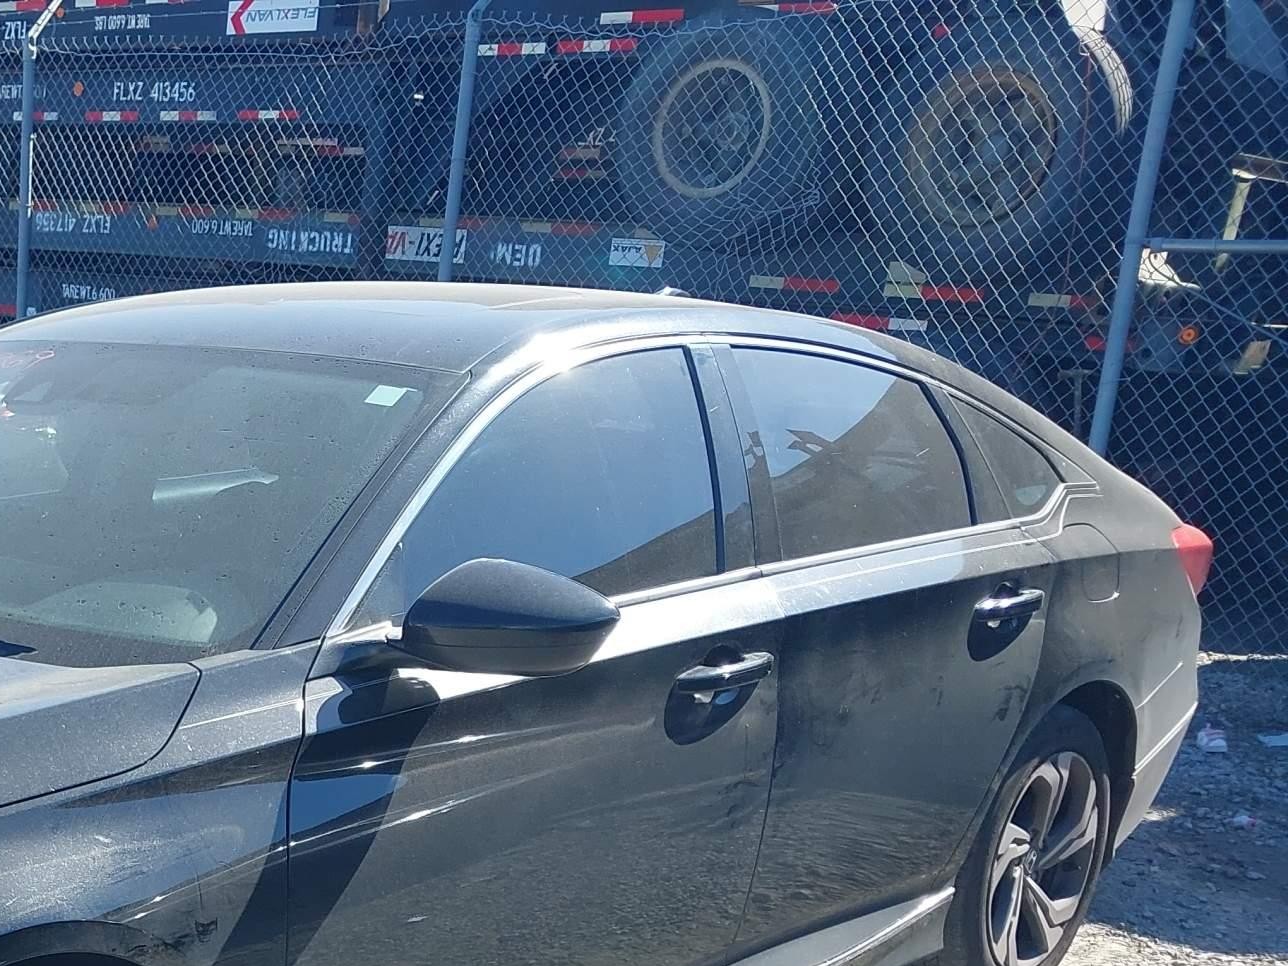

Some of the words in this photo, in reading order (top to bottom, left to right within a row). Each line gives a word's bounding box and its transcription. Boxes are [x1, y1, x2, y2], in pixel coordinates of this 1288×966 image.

[113, 81, 144, 101] FLXZ
[150, 81, 196, 102] 413456
[36, 212, 77, 232] 417356
[82, 214, 111, 233] FLXZ
[268, 229, 353, 254] TRUCKING
[612, 244, 642, 254] AJAX
